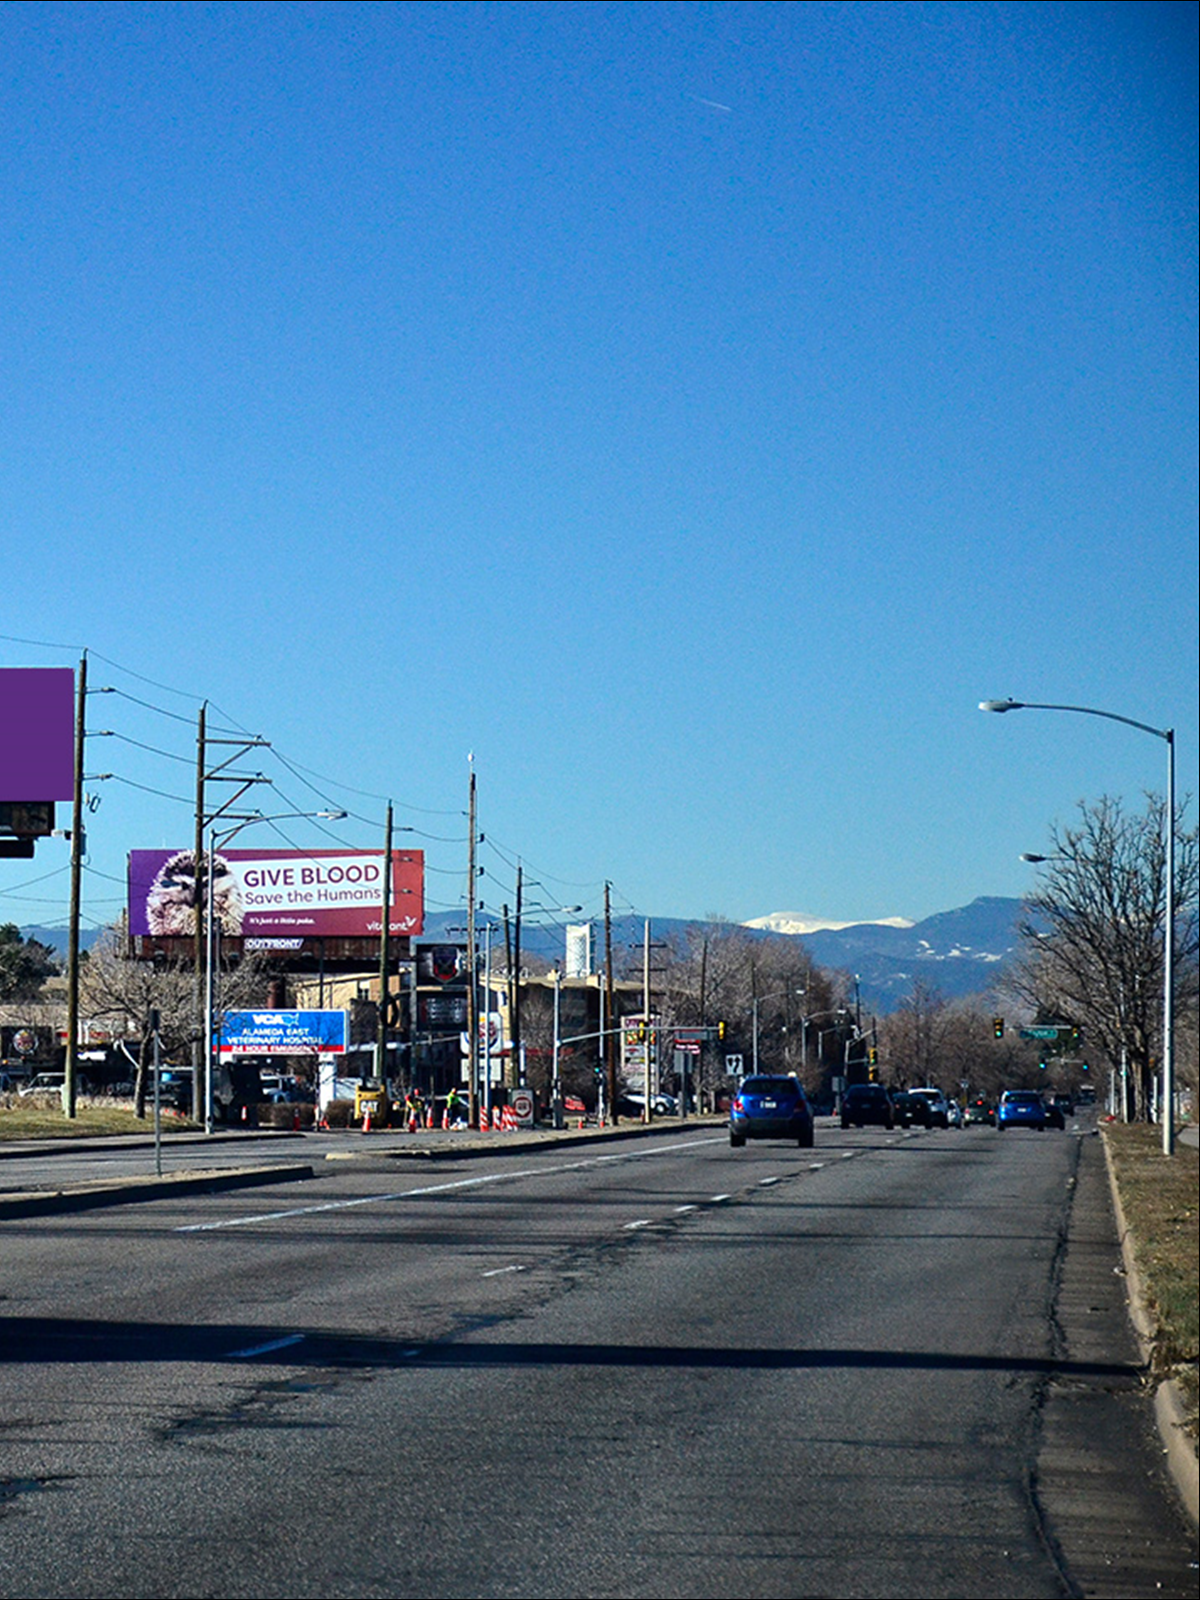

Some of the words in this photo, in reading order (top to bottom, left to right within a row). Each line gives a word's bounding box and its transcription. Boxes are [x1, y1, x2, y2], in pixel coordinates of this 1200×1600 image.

[243, 868, 295, 887] GIVE
[301, 864, 380, 885] BLOOD
[244, 892, 284, 905] Save
[287, 889, 314, 903] the
[317, 888, 382, 902] Humans
[252, 1014, 285, 1025] VCA
[241, 1028, 284, 1036] ALAMEDA
[286, 1028, 310, 1036] EAST
[226, 1037, 280, 1045] VETERINARY
[283, 1037, 324, 1045] HOSPITAL
